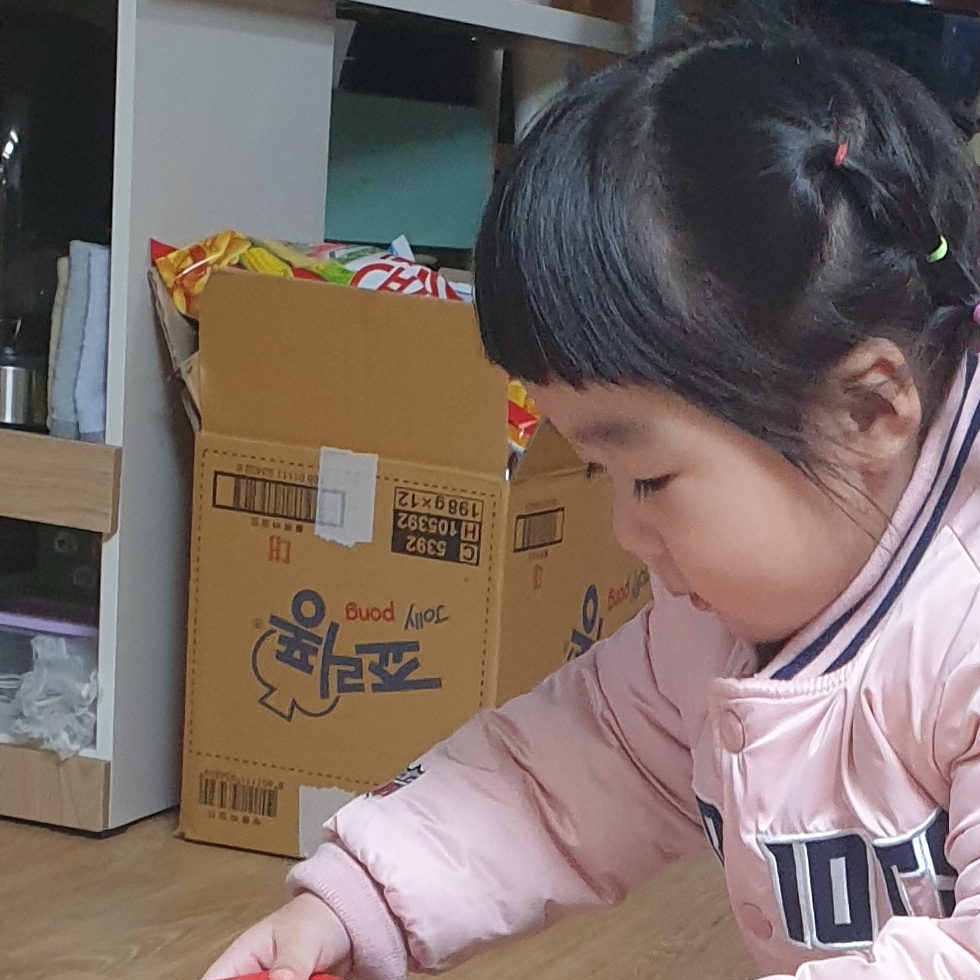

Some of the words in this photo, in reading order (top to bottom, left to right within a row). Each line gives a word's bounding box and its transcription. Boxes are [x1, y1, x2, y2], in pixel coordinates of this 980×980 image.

[397, 513, 457, 536] 105392
[406, 535, 447, 557] 5392
[404, 603, 449, 630] Jolly
[269, 589, 442, 699] 죠리퐁
